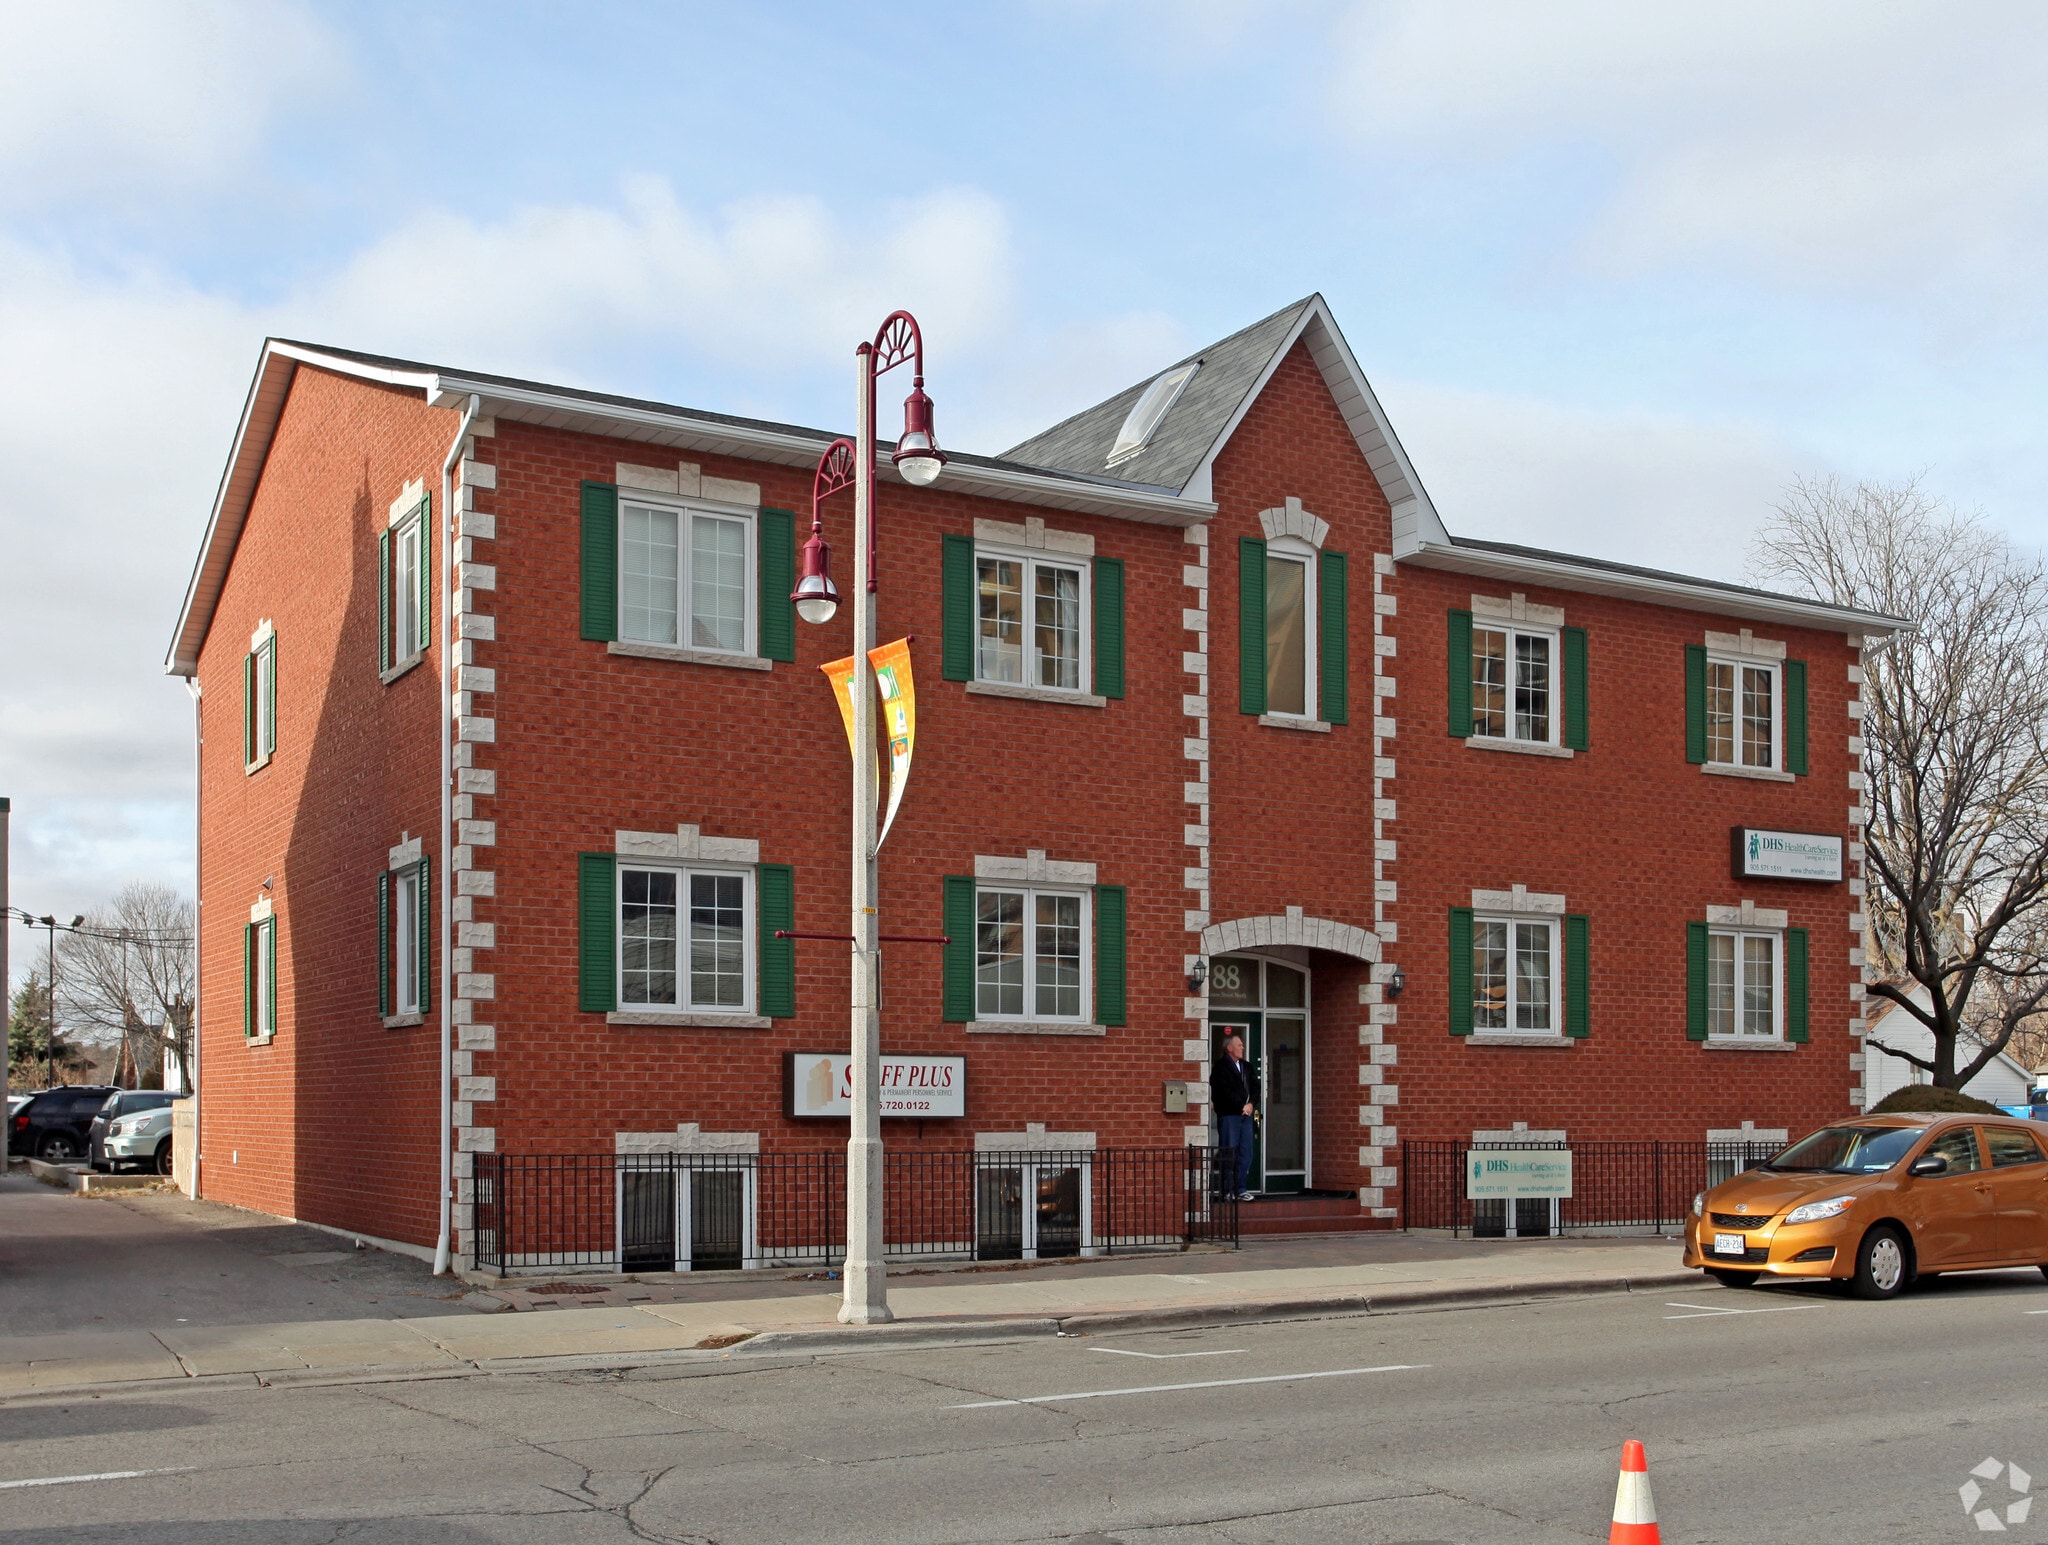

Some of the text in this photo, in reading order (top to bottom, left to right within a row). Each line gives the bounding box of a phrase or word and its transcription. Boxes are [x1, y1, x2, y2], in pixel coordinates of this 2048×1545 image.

[1762, 837, 1784, 851] DHS
[1212, 964, 1241, 989] 88
[841, 1064, 953, 1099] SFF PLUS
[912, 1089, 936, 1097] PERSONNEL
[936, 1089, 953, 1097] SERVICE
[1486, 1159, 1509, 1172] DHS
